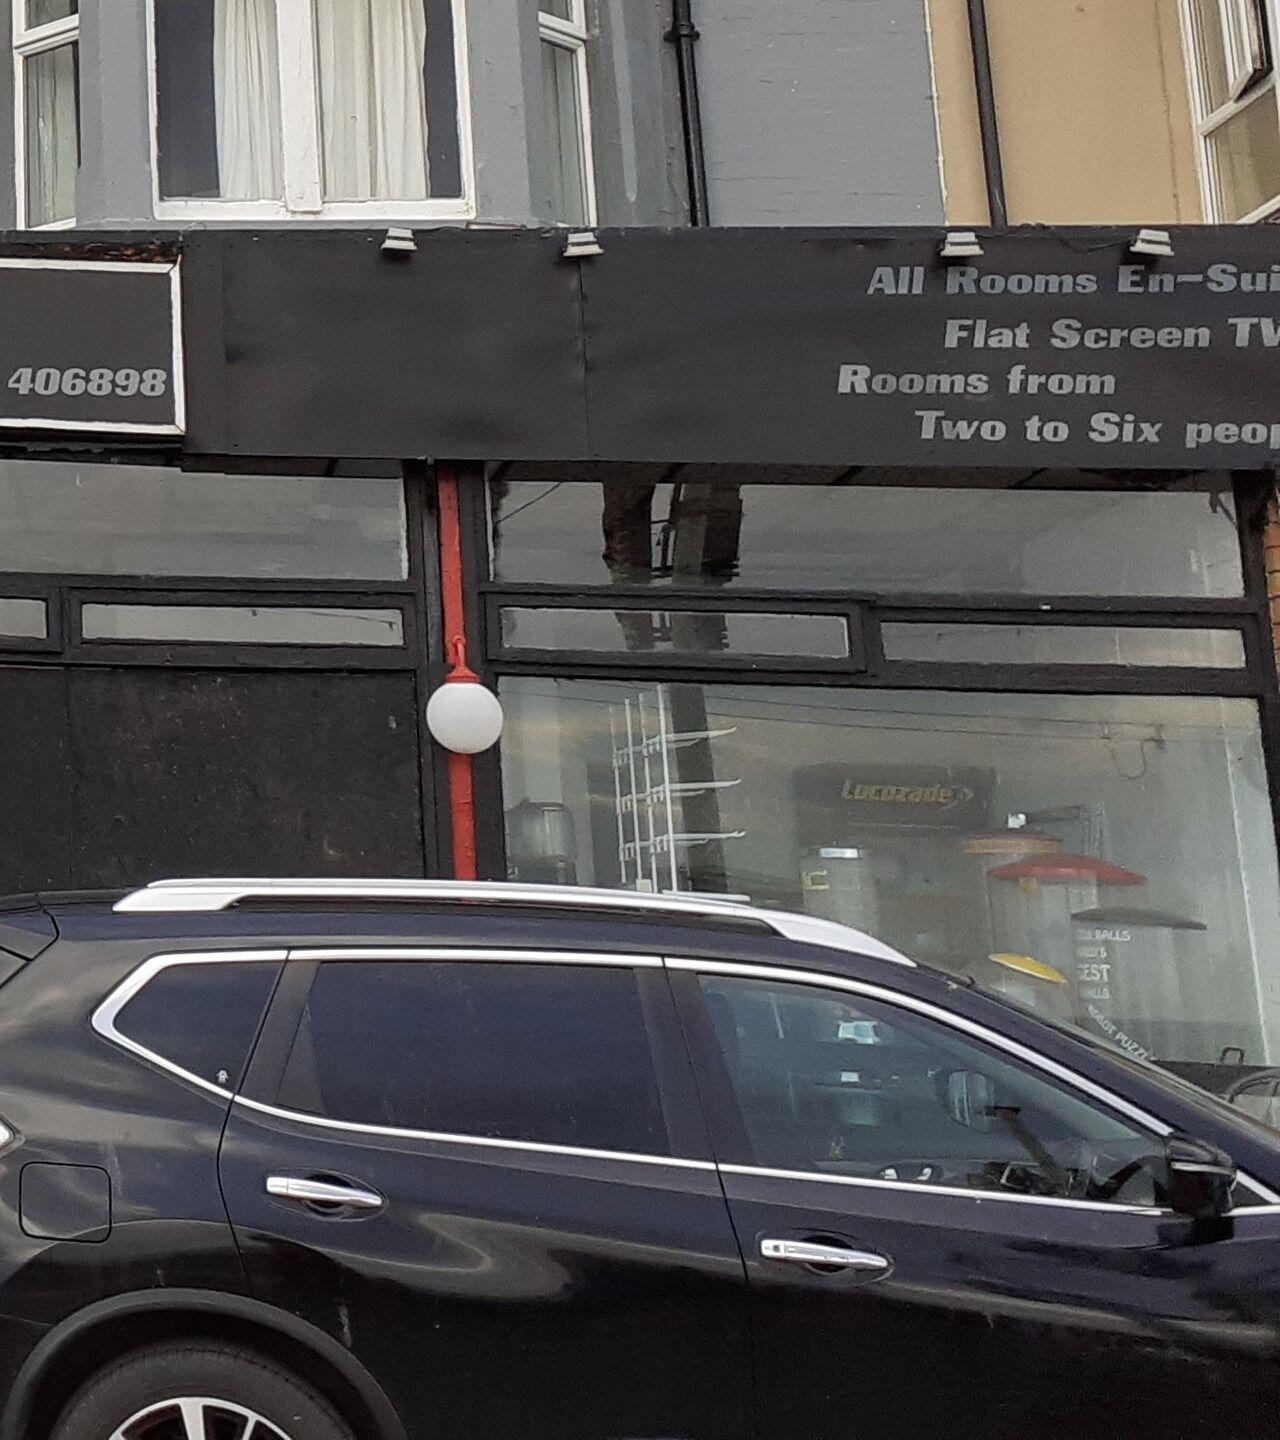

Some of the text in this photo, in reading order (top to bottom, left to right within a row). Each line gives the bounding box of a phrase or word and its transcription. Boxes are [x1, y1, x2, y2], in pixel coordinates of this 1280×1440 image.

[867, 267, 924, 294] All
[946, 266, 1098, 294] Rooms
[944, 318, 1030, 348] Flat
[1049, 318, 1211, 349] Screen
[7, 367, 168, 397] 406898
[838, 364, 1116, 395] Rooms from
[915, 409, 1007, 441] Two
[1024, 414, 1070, 442] to
[1088, 411, 1162, 443] Six
